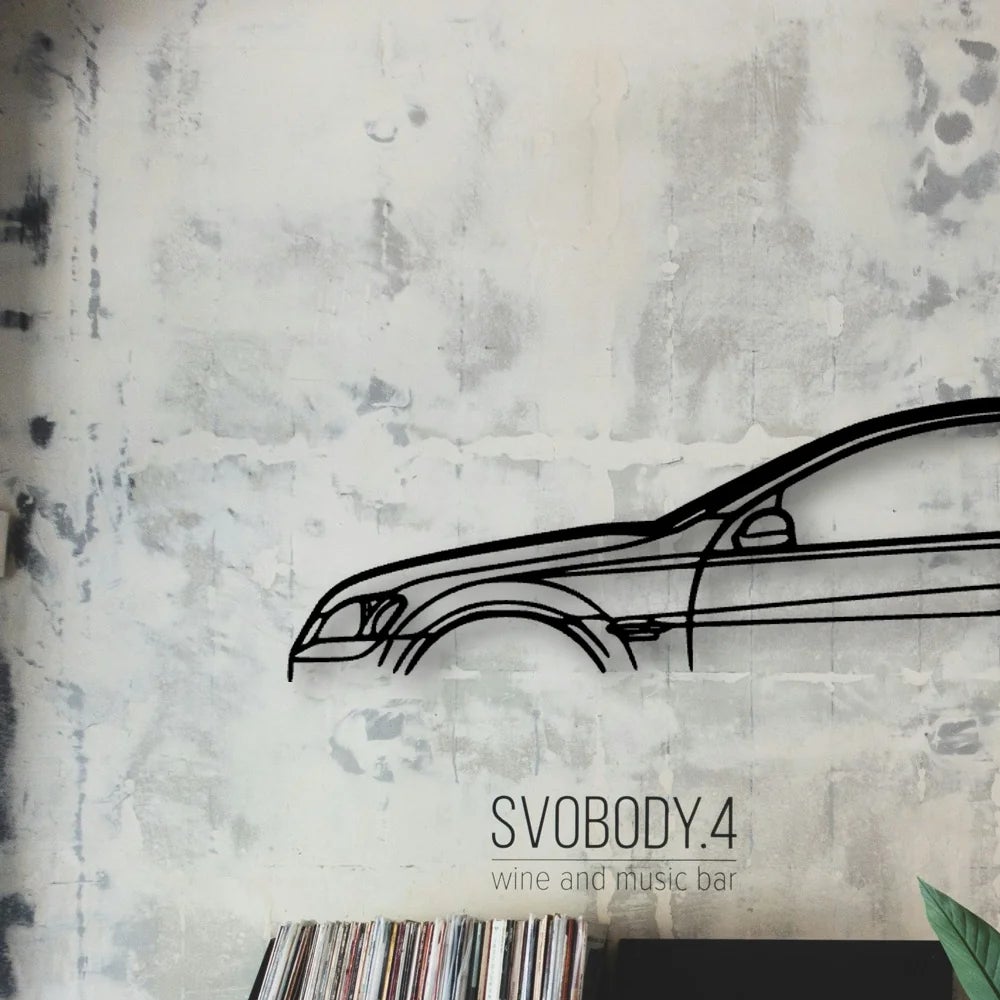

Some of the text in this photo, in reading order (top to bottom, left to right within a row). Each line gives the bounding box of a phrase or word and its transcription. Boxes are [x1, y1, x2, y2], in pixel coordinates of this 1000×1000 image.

[491, 795, 738, 849] SVOBODY.4
[491, 865, 737, 891] wine and music bar
